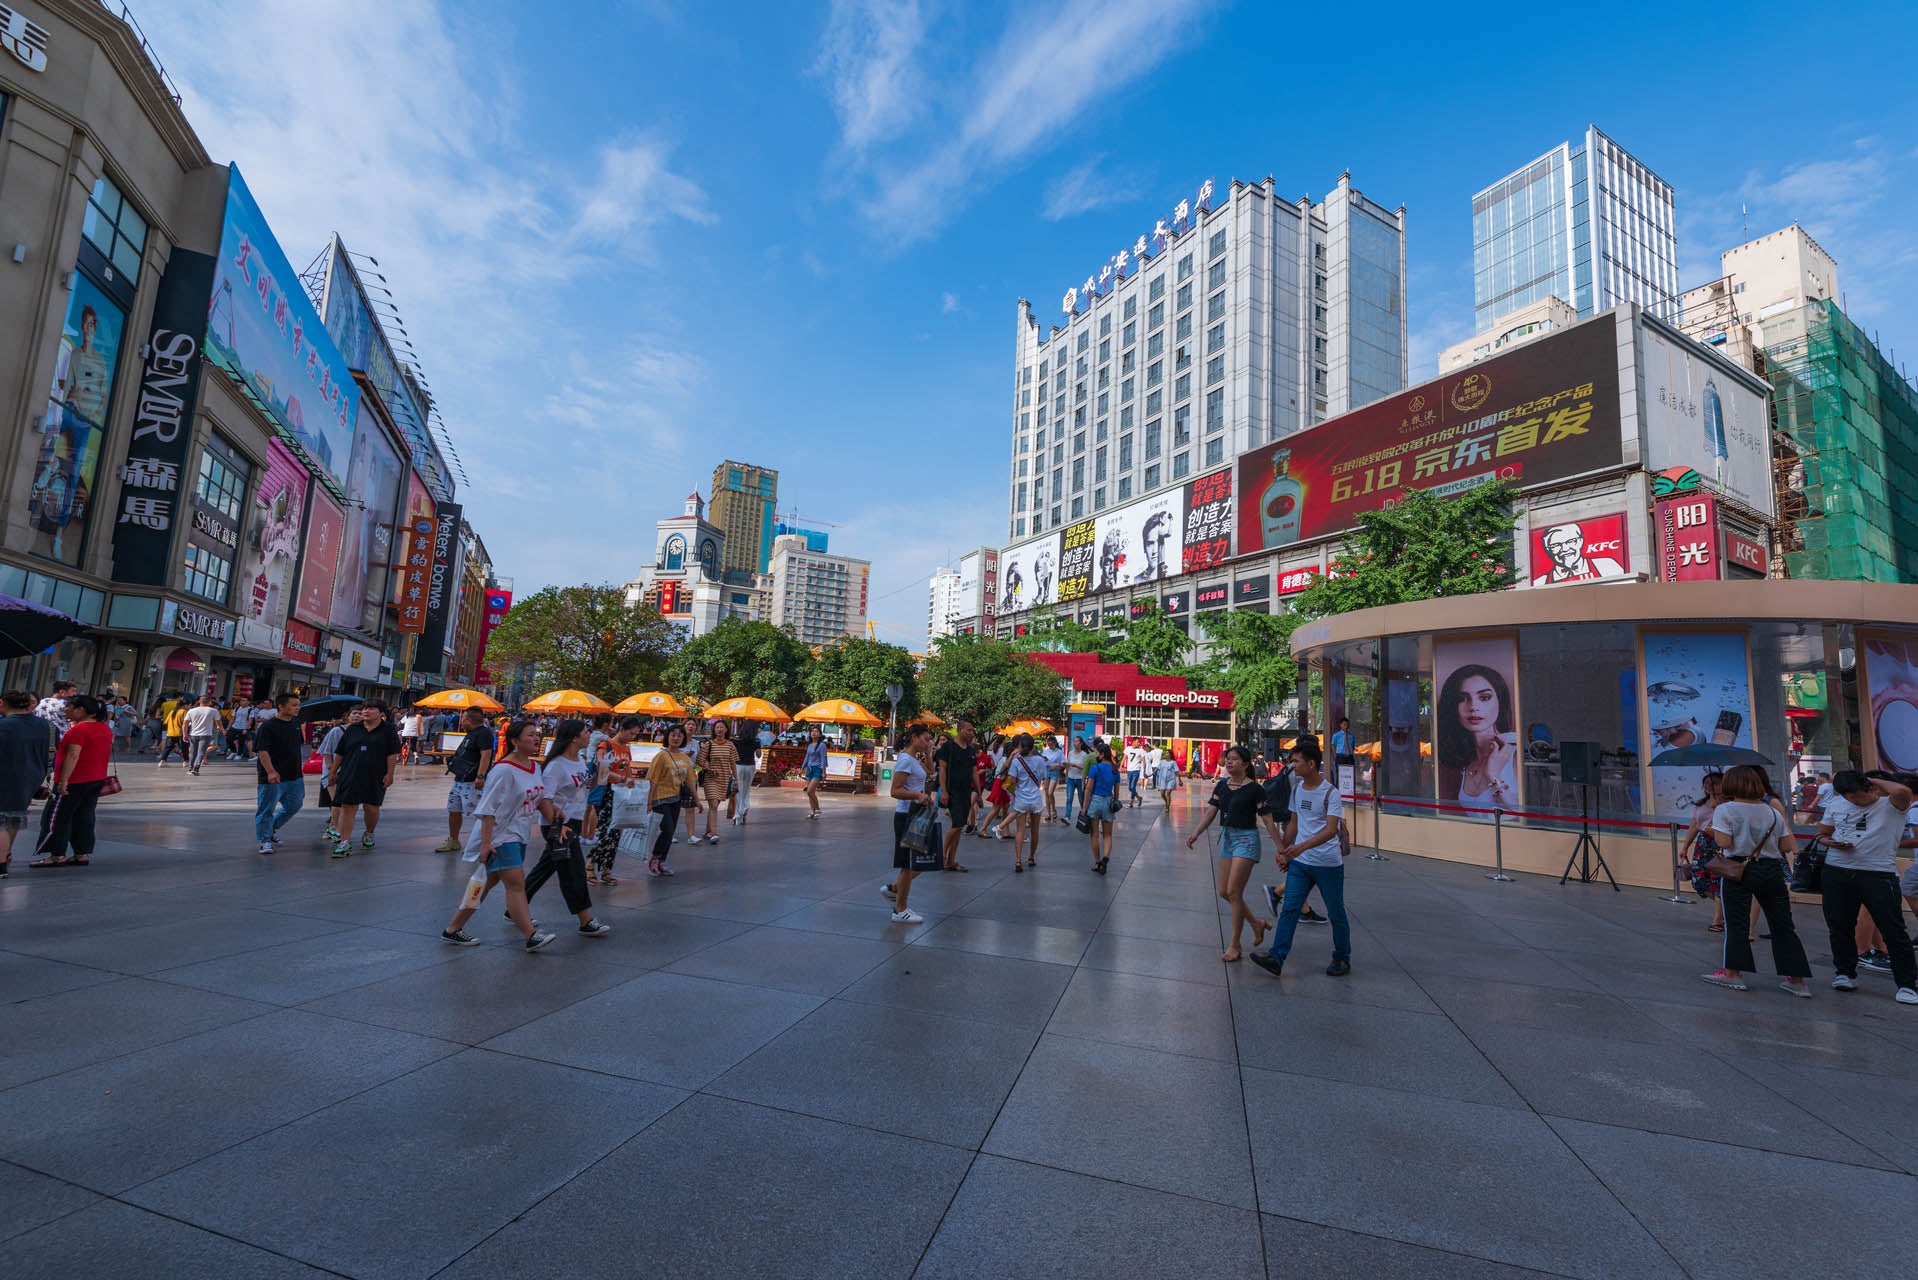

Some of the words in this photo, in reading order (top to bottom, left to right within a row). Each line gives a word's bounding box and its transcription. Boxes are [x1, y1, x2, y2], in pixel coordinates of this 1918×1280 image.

[133, 328, 195, 443] SEMIR
[1331, 460, 1402, 503] 6.18
[1412, 401, 1594, 481] 京东首发
[196, 510, 222, 541] SEMIR
[1188, 497, 1232, 529] 创造力
[1185, 520, 1231, 544] 就是答案
[1664, 508, 1676, 552] SUNSHINE
[1676, 503, 1710, 567] 阳光
[1062, 544, 1093, 567] 创造力
[1182, 538, 1229, 566] 创造力
[1586, 540, 1620, 553] KFC
[1736, 541, 1758, 564] KFC
[428, 513, 456, 610] Meters/bonwe
[1060, 561, 1090, 579] 就是答案
[984, 559, 997, 638] 阳光百货
[1058, 575, 1088, 598] 创造力
[178, 609, 211, 638] SEMIR
[1129, 752, 1137, 762] 7
